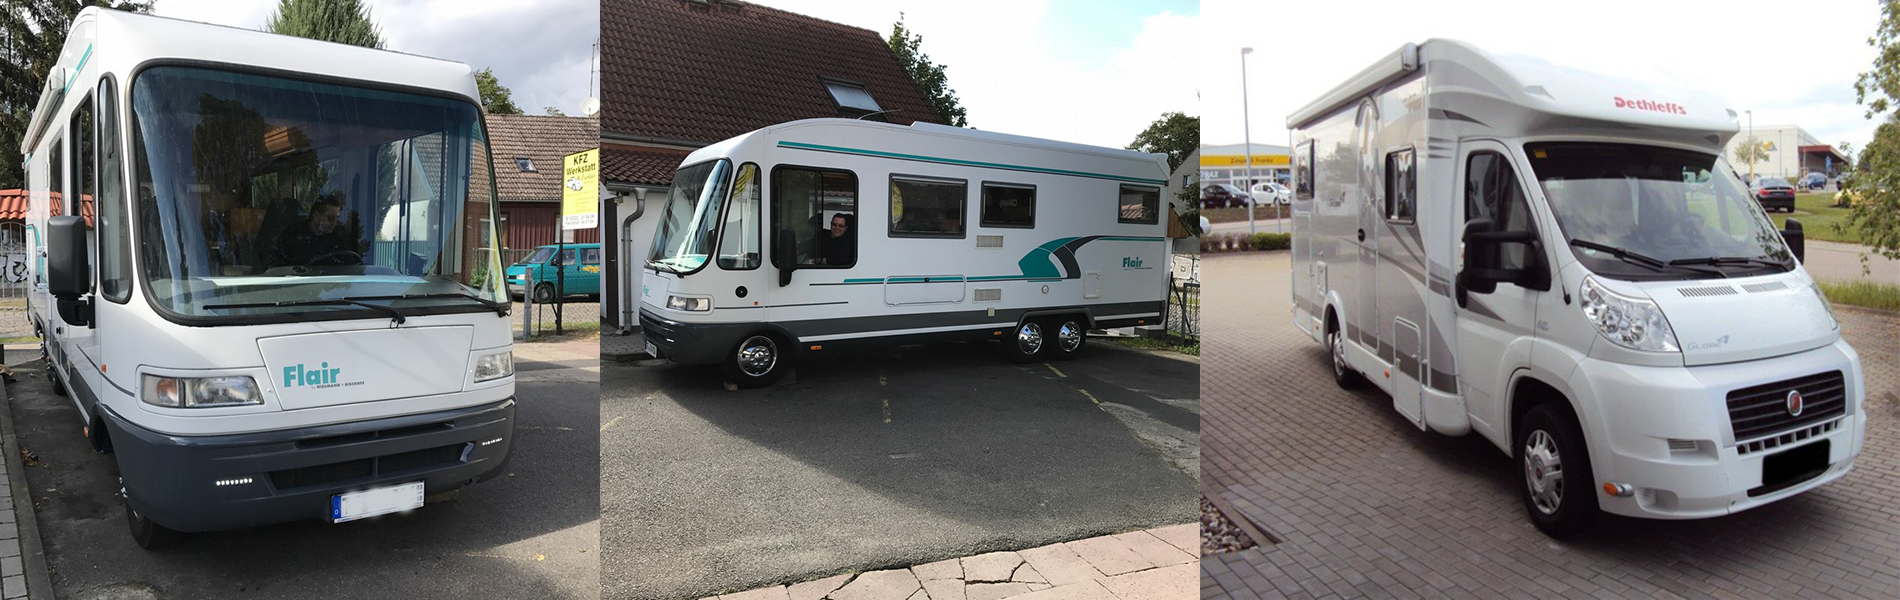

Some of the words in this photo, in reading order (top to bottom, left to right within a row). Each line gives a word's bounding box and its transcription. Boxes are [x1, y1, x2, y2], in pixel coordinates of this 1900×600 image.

[1614, 96, 1687, 115] Dethleffs
[573, 153, 588, 166] KFZ
[566, 162, 596, 176] Werkstatt
[1122, 256, 1143, 268] Flair
[283, 361, 341, 388] Flair
